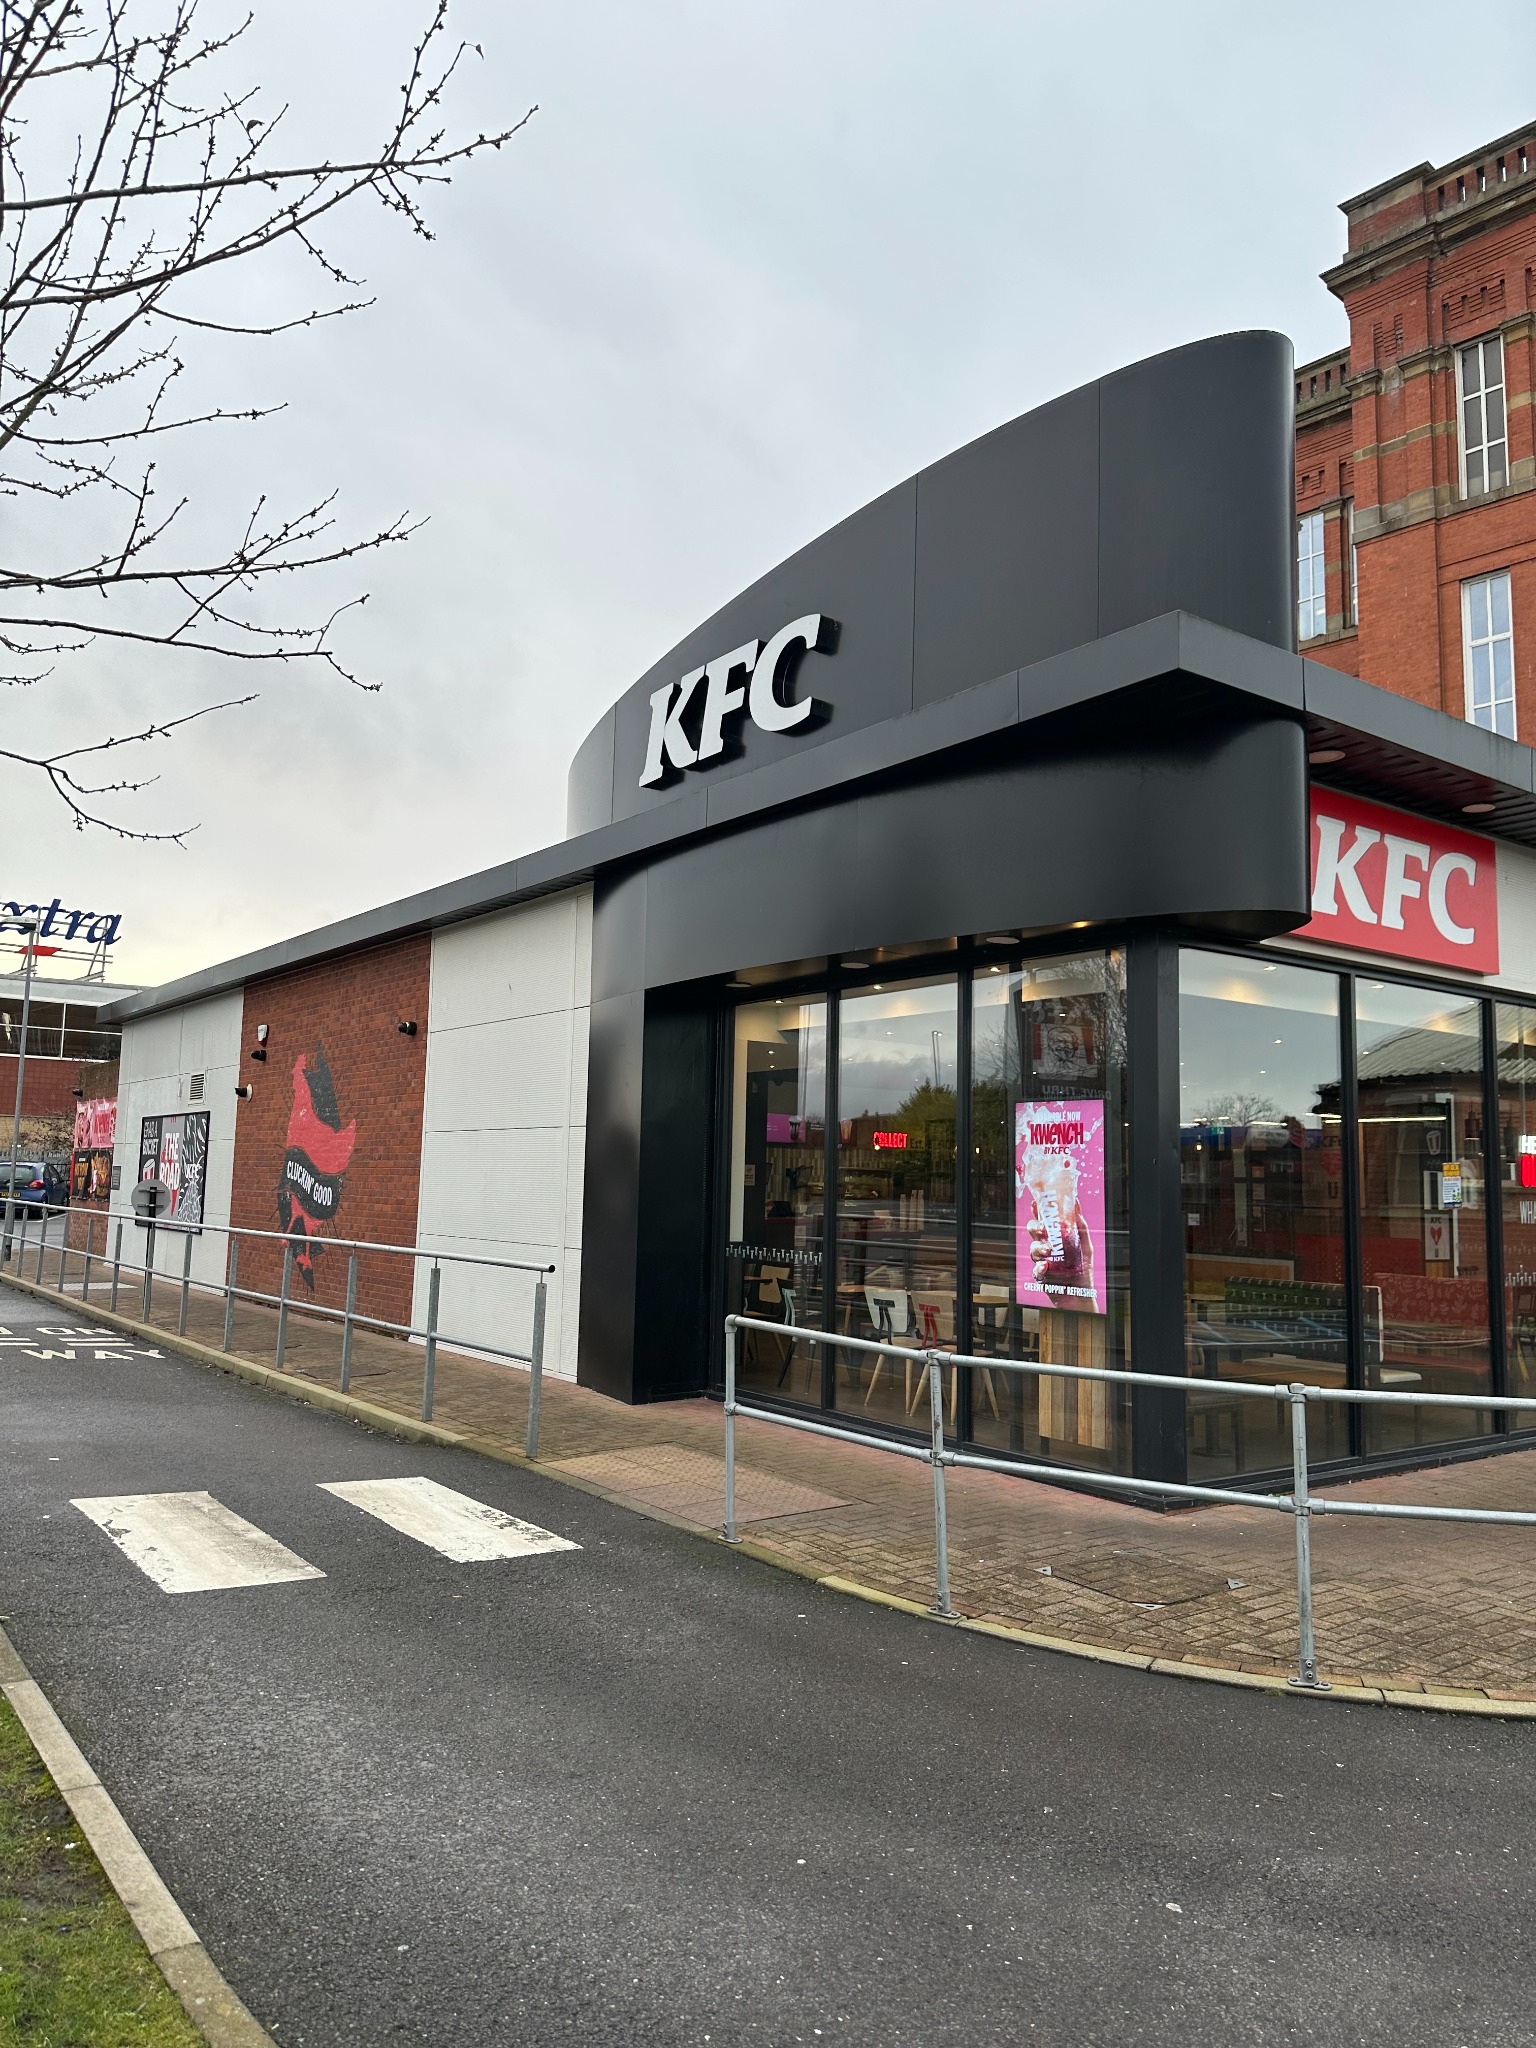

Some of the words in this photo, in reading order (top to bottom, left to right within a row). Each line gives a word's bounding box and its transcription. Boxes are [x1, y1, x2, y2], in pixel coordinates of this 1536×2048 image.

[638, 613, 822, 787] KFC
[1311, 814, 1477, 945] KFC
[164, 1132, 180, 1161] THE
[1051, 1146, 1070, 1155] KFC
[159, 1162, 181, 1190] ROAD
[286, 1160, 315, 1195] CLUCKIN'
[313, 1182, 333, 1206] GOOD
[1023, 1281, 1044, 1293] CHERRY
[1066, 1286, 1098, 1299] REFRESHER
[21, 1349, 167, 1361] WAY
